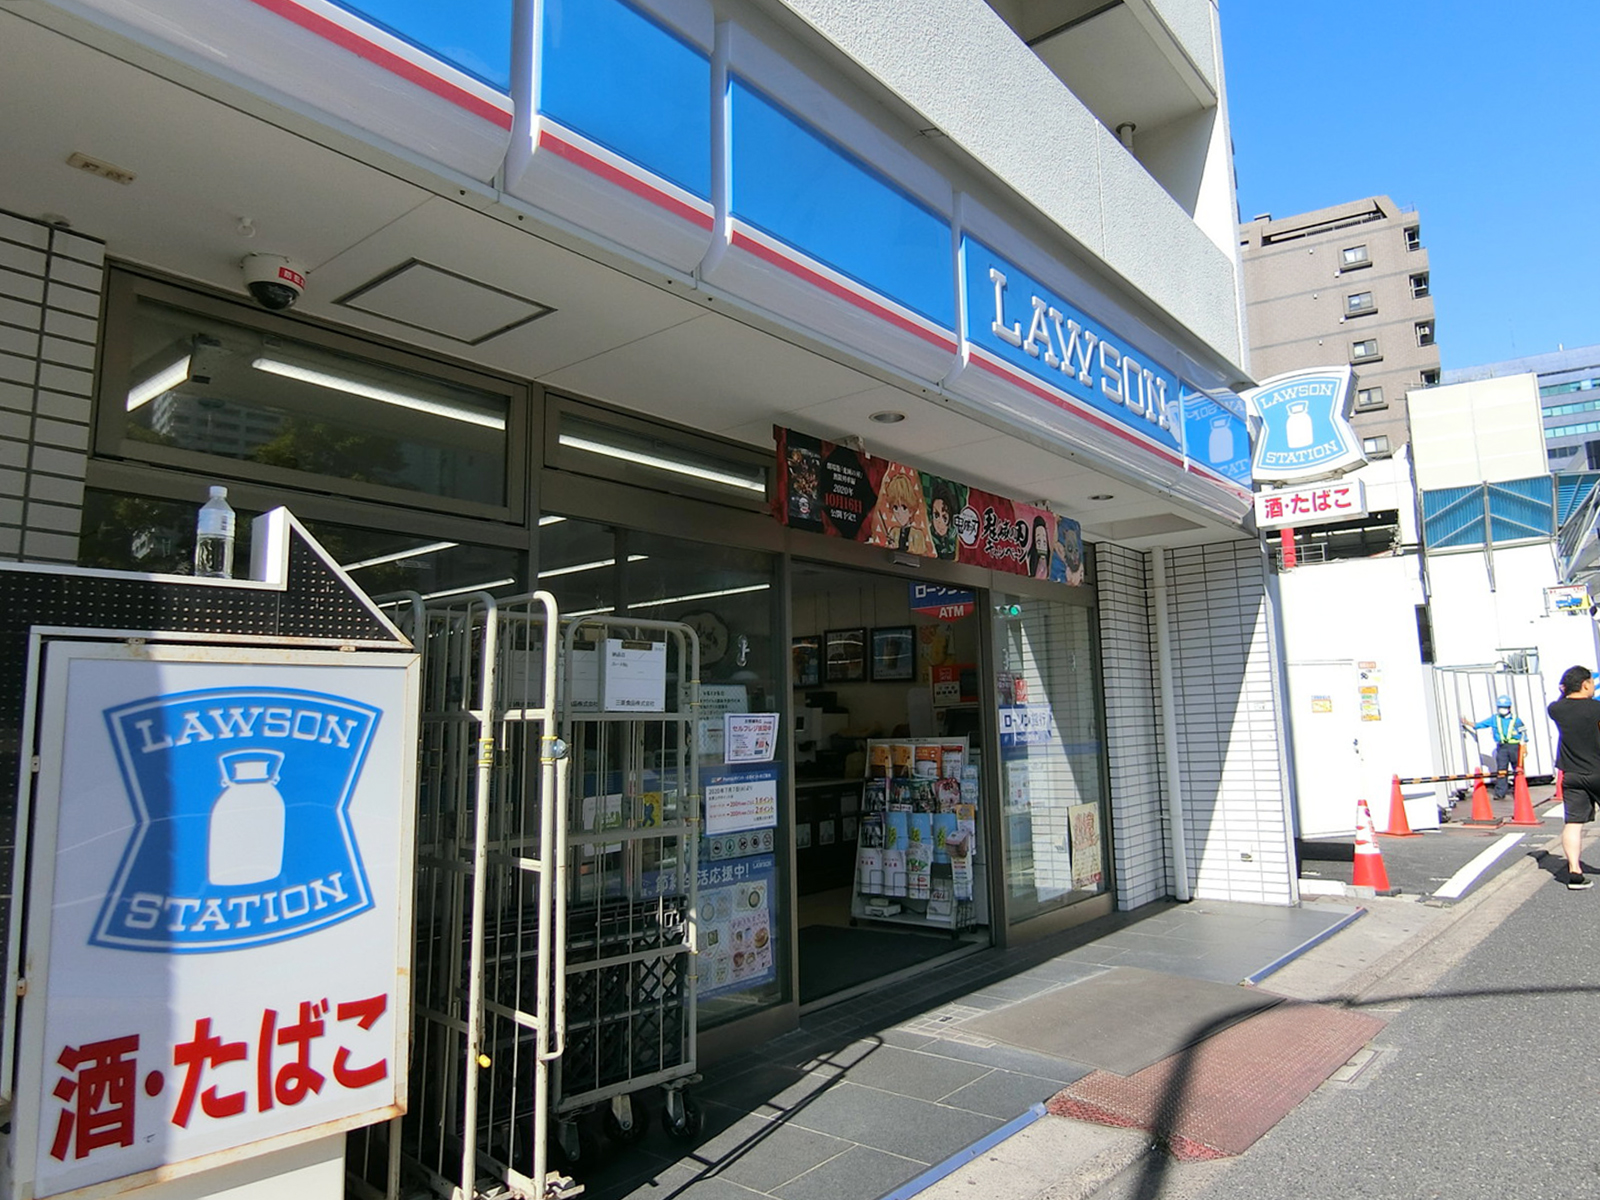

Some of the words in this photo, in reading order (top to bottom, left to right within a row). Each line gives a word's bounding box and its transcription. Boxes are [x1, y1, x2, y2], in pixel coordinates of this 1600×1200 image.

[989, 267, 1171, 431] LAWSON
[1260, 383, 1334, 409] LAWSON
[1265, 440, 1339, 464] STATION
[1264, 488, 1352, 519] 酒・たばこ
[939, 605, 964, 619] ATM
[134, 706, 359, 754] LAWSON
[124, 872, 349, 932] STATION
[50, 993, 389, 1162] 酒・たばこ
